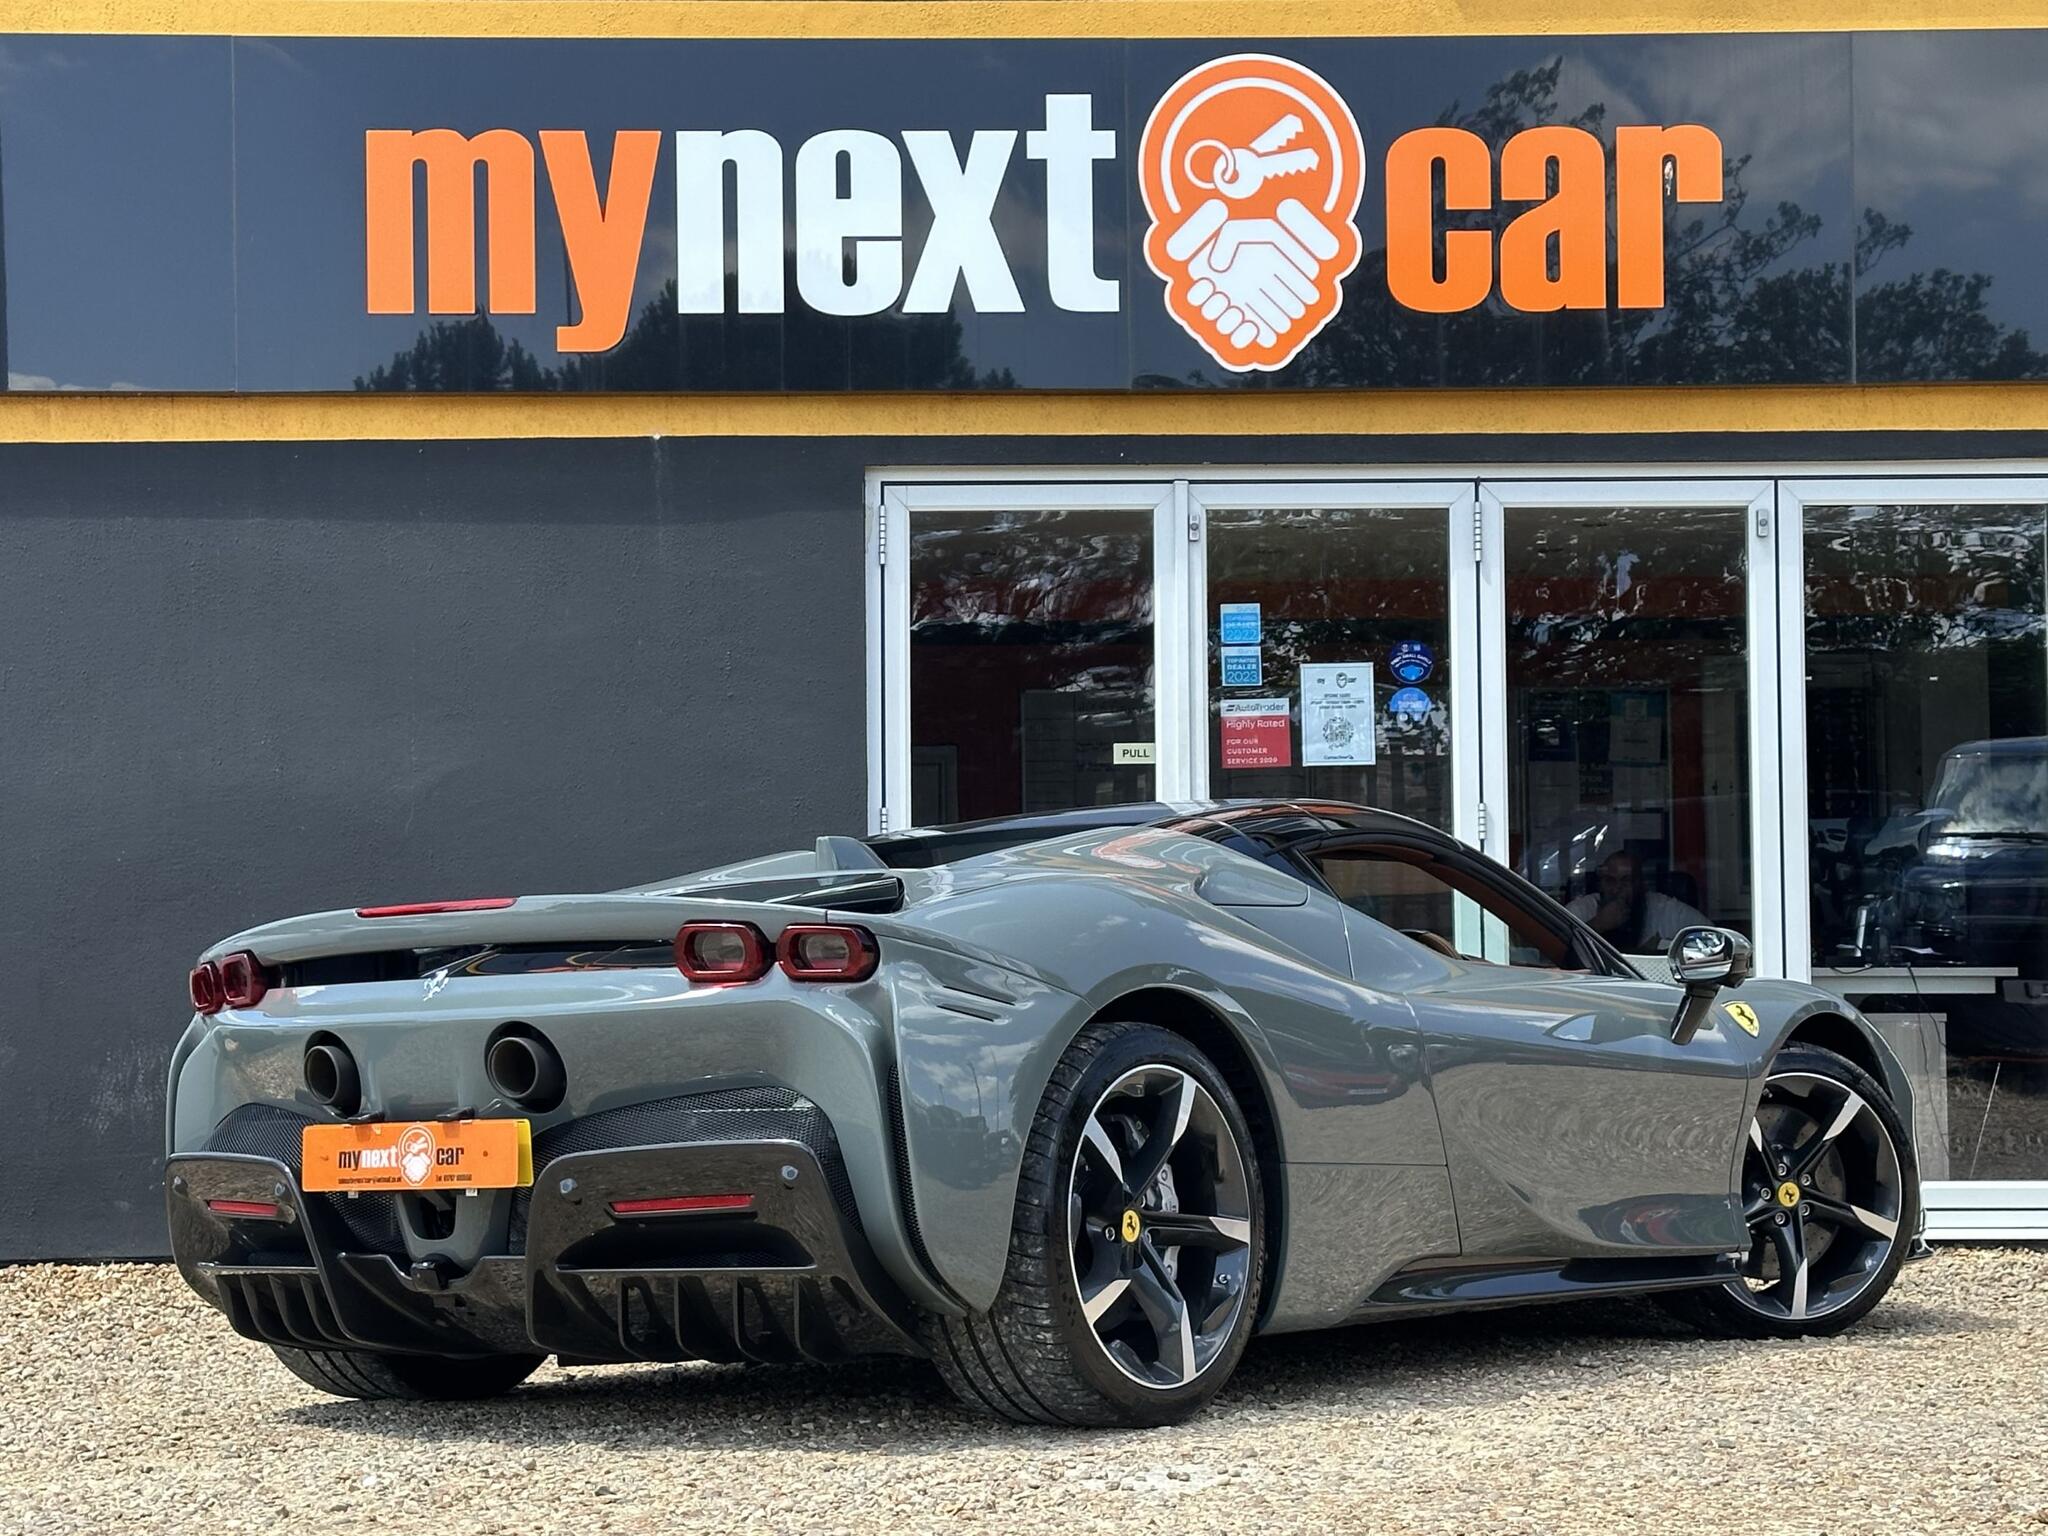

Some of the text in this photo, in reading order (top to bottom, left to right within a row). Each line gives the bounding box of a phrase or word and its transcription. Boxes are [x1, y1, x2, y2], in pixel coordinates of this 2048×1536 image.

[1386, 126, 1724, 312] car
[1226, 630, 1257, 641] 2022
[1227, 671, 1258, 682] 2023
[1235, 703, 1285, 712] AutoTrader
[1226, 719, 1285, 730] Highly Rated
[1122, 749, 1151, 758] PULL
[1227, 747, 1268, 755] CUSTOMER
[436, 1147, 465, 1166] car
